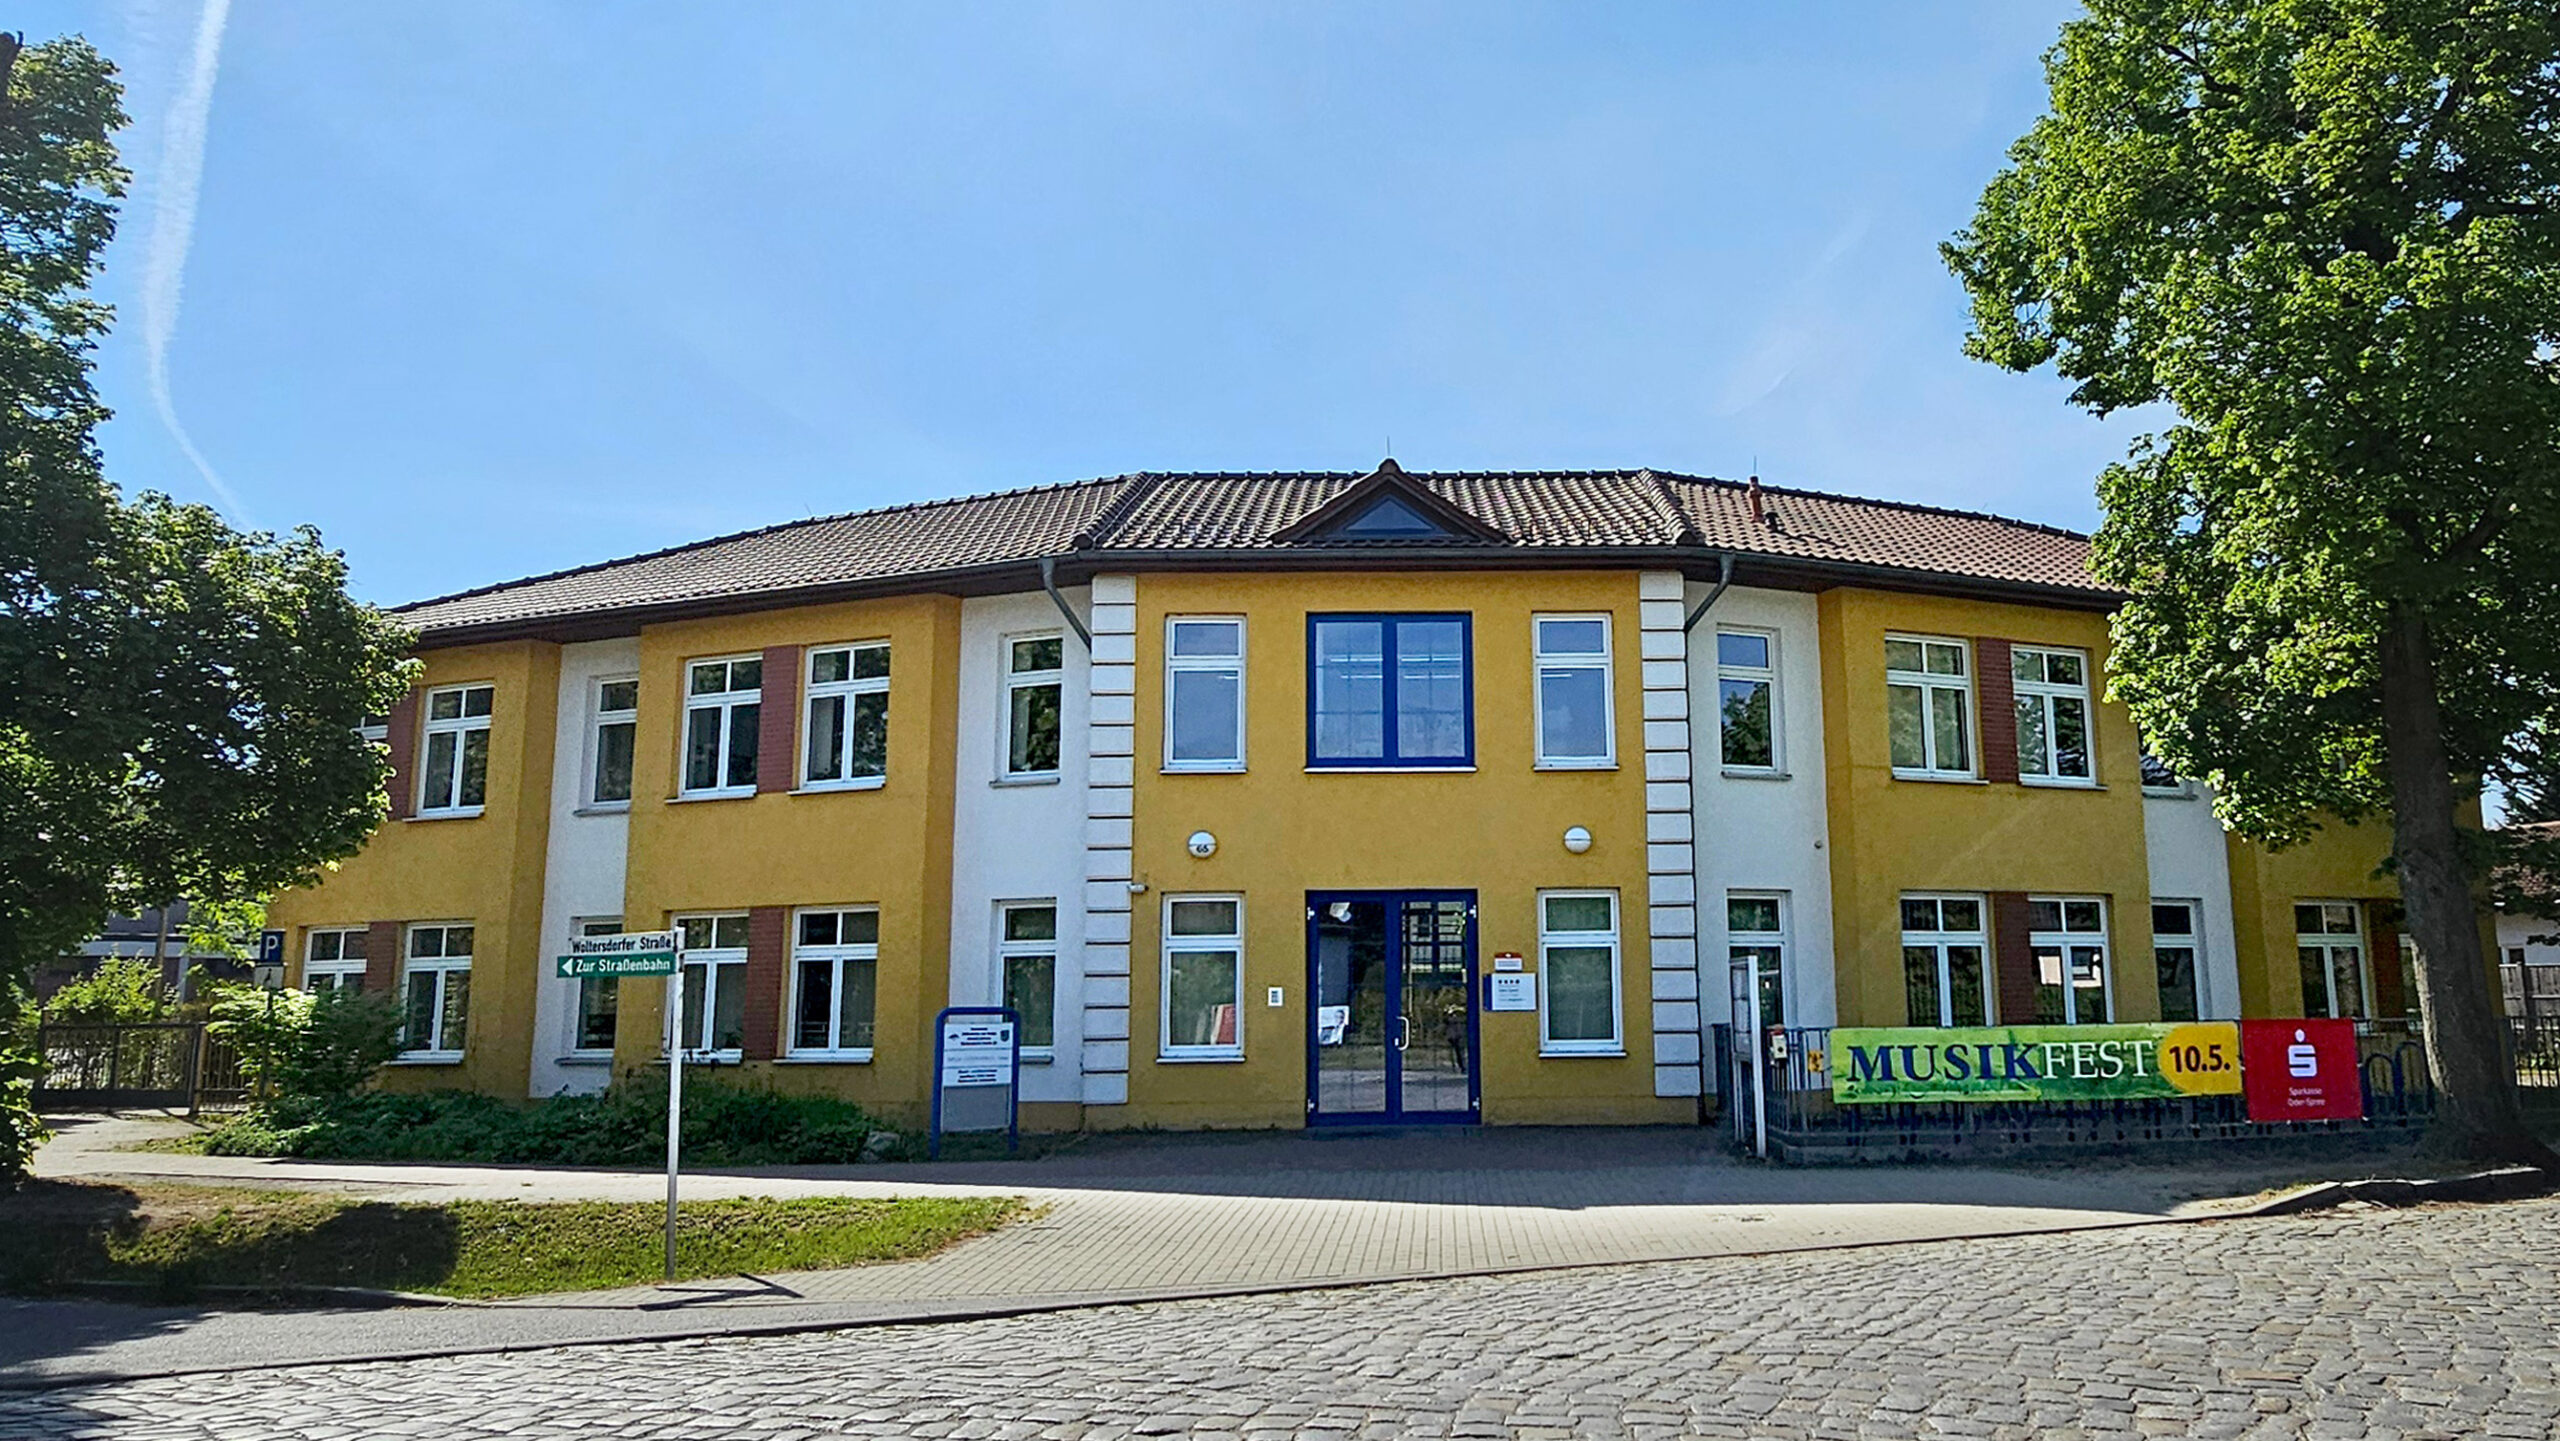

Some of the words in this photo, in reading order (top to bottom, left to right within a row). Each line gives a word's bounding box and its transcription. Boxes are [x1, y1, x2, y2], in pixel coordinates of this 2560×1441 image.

[572, 938, 635, 953] Woltersdorfer
[640, 936, 672, 949] Straße
[576, 960, 596, 972] Zur
[598, 959, 671, 972] Straßenbahn
[1847, 1040, 2153, 1082] MUSIKFEST
[2169, 1045, 2231, 1073] 10.5.
[2288, 1086, 2323, 1097] Sparkasse
